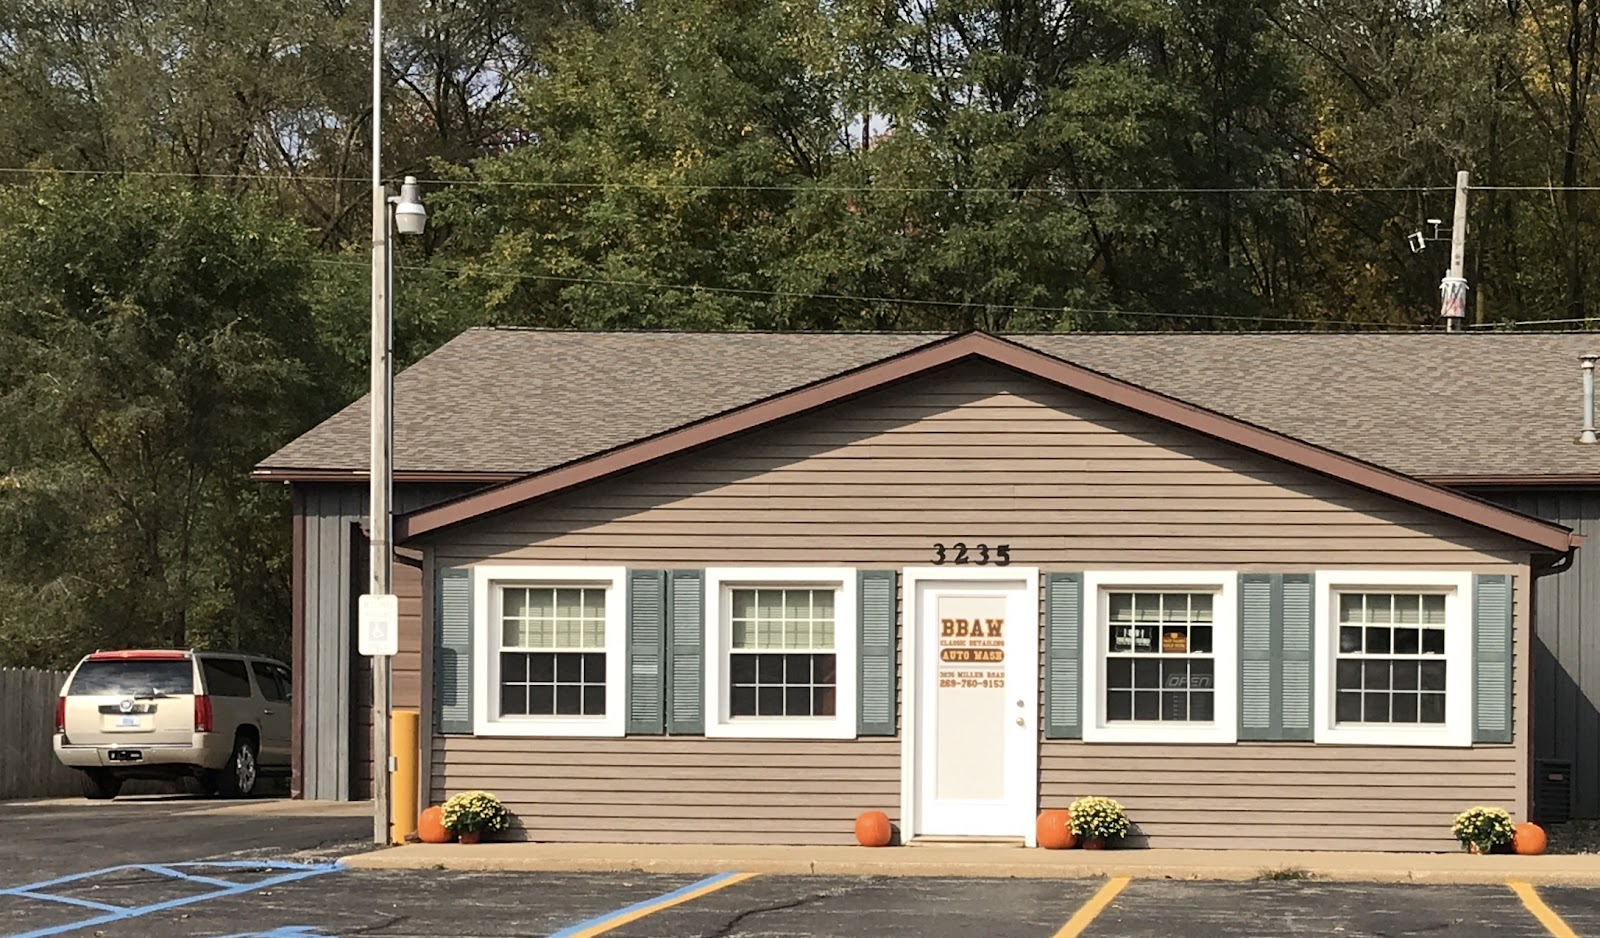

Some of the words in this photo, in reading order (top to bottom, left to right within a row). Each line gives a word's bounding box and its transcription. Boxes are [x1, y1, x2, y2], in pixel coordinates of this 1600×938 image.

[930, 543, 1010, 566] 3235
[941, 618, 1004, 637] BBAW
[942, 650, 970, 660] AUTO
[973, 650, 1003, 660] WASH
[940, 679, 1005, 688] 269-760-9153
[1168, 676, 1210, 687] OPEN
